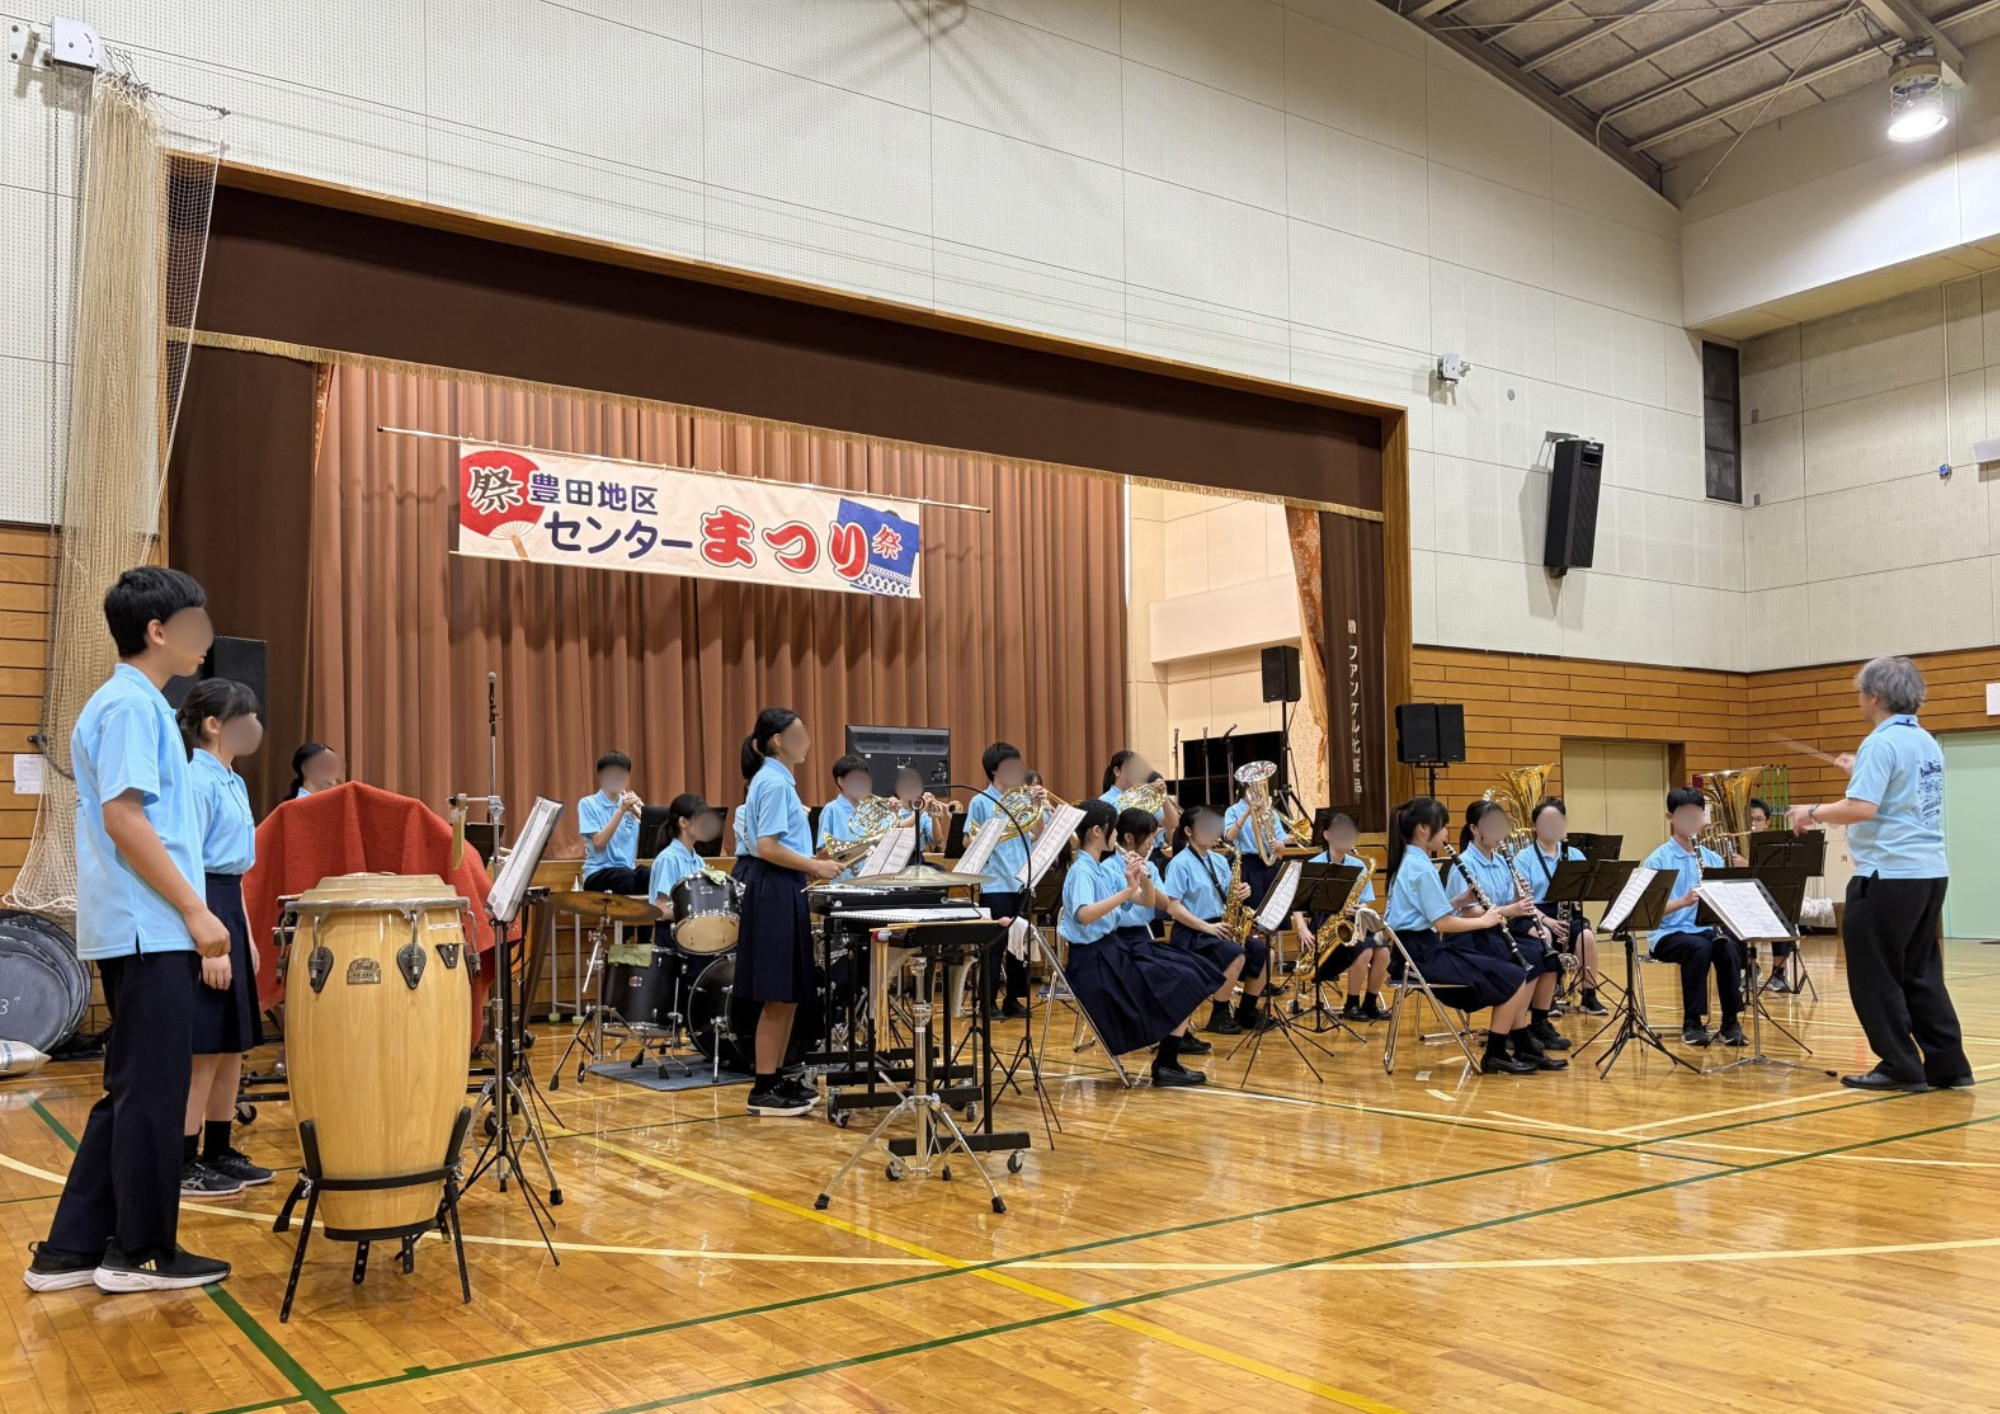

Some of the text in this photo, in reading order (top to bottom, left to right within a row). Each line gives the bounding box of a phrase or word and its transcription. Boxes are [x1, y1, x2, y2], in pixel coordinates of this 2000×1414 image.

[467, 465, 524, 515] 祭
[530, 473, 659, 515] 豊田地区
[871, 523, 903, 560] 祭
